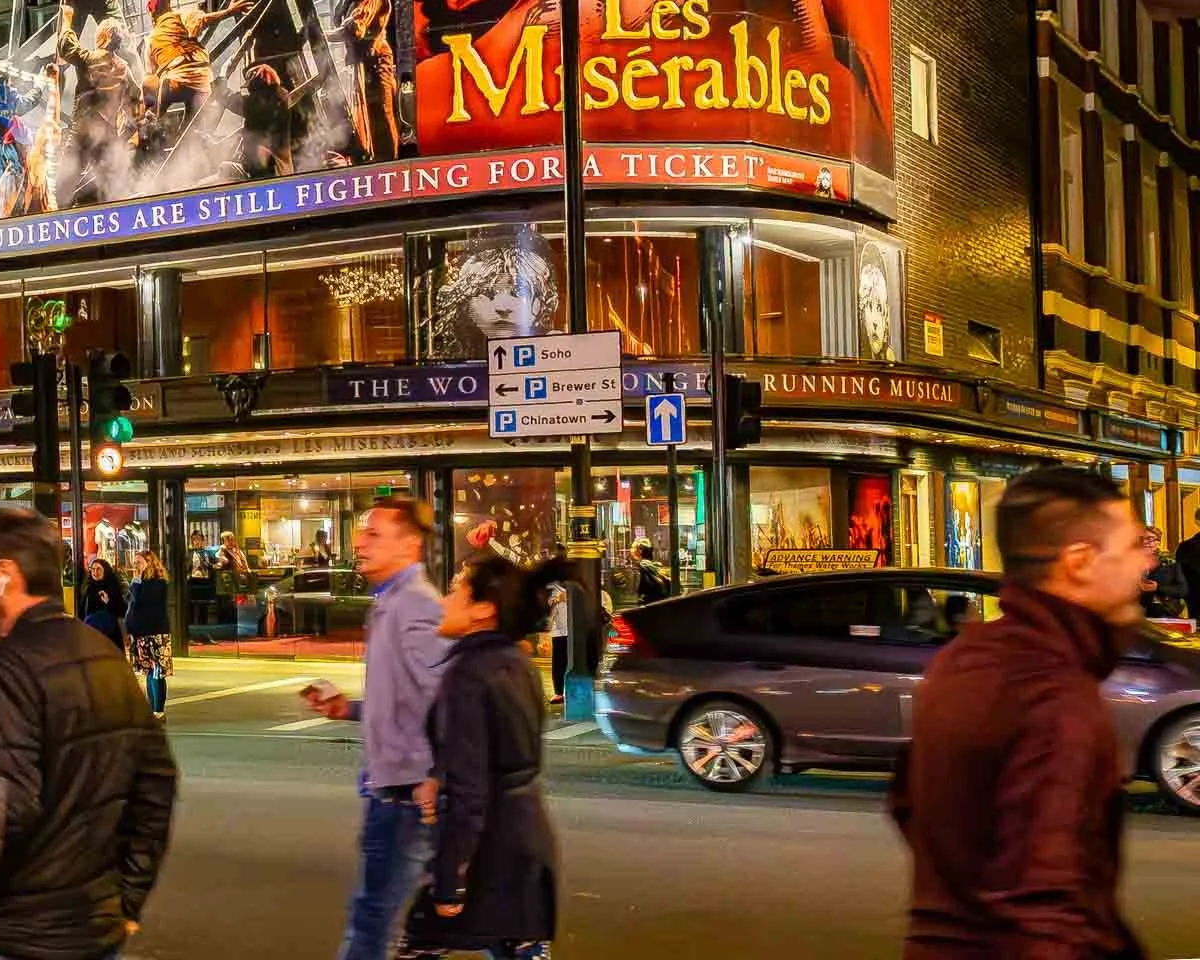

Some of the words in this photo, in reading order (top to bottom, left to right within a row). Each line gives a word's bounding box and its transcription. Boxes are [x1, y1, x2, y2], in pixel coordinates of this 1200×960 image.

[133, 200, 186, 230] ARE
[199, 188, 283, 221] STILL
[296, 164, 468, 212] FIGHTING
[488, 156, 564, 185] FOR
[582, 153, 602, 177] A
[518, 346, 532, 365] P
[541, 349, 572, 360] Soho
[350, 377, 411, 398] THE
[531, 379, 545, 398] P
[552, 380, 596, 393] Brewer
[601, 378, 617, 390] St
[763, 373, 881, 396] RUNNING
[890, 379, 953, 402] MUSICAL
[500, 412, 514, 430] P
[521, 414, 587, 426] Chinatown
[772, 553, 817, 562] ADVANCE
[822, 553, 871, 562] WARNING
